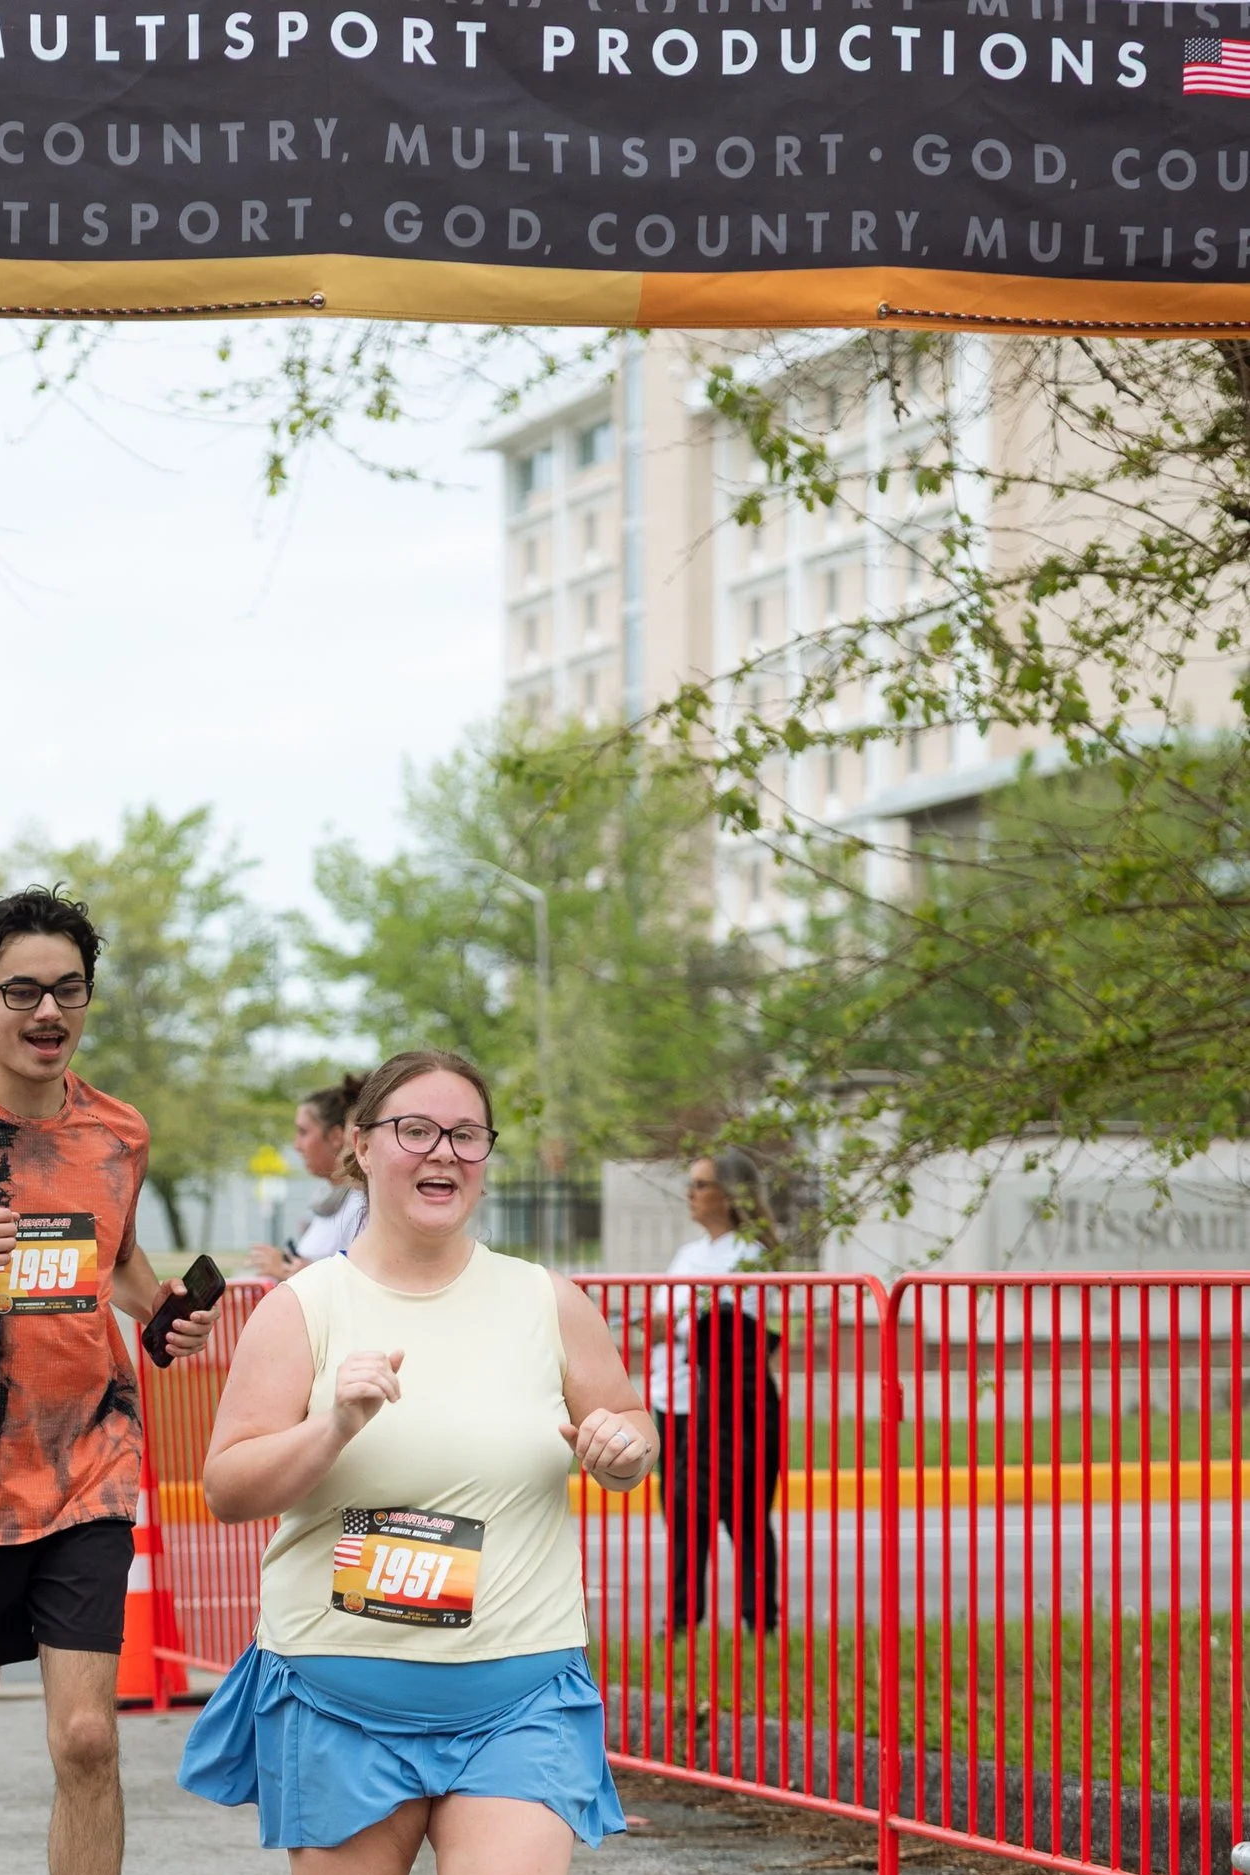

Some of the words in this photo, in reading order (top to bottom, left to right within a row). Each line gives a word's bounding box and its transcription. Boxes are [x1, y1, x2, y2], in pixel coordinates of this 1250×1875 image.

[542, 23, 1147, 90] PRODUCTIONS
[385, 122, 844, 180] MULTISPORT
[912, 133, 1078, 190] GOD,
[1112, 147, 1249, 192] COU
[383, 200, 551, 256] GOD,
[588, 210, 929, 258] COUNTRY,
[8, 1248, 79, 1290] 1959
[389, 1512, 455, 1530] HEARTLAND
[366, 1544, 453, 1600] 1951
